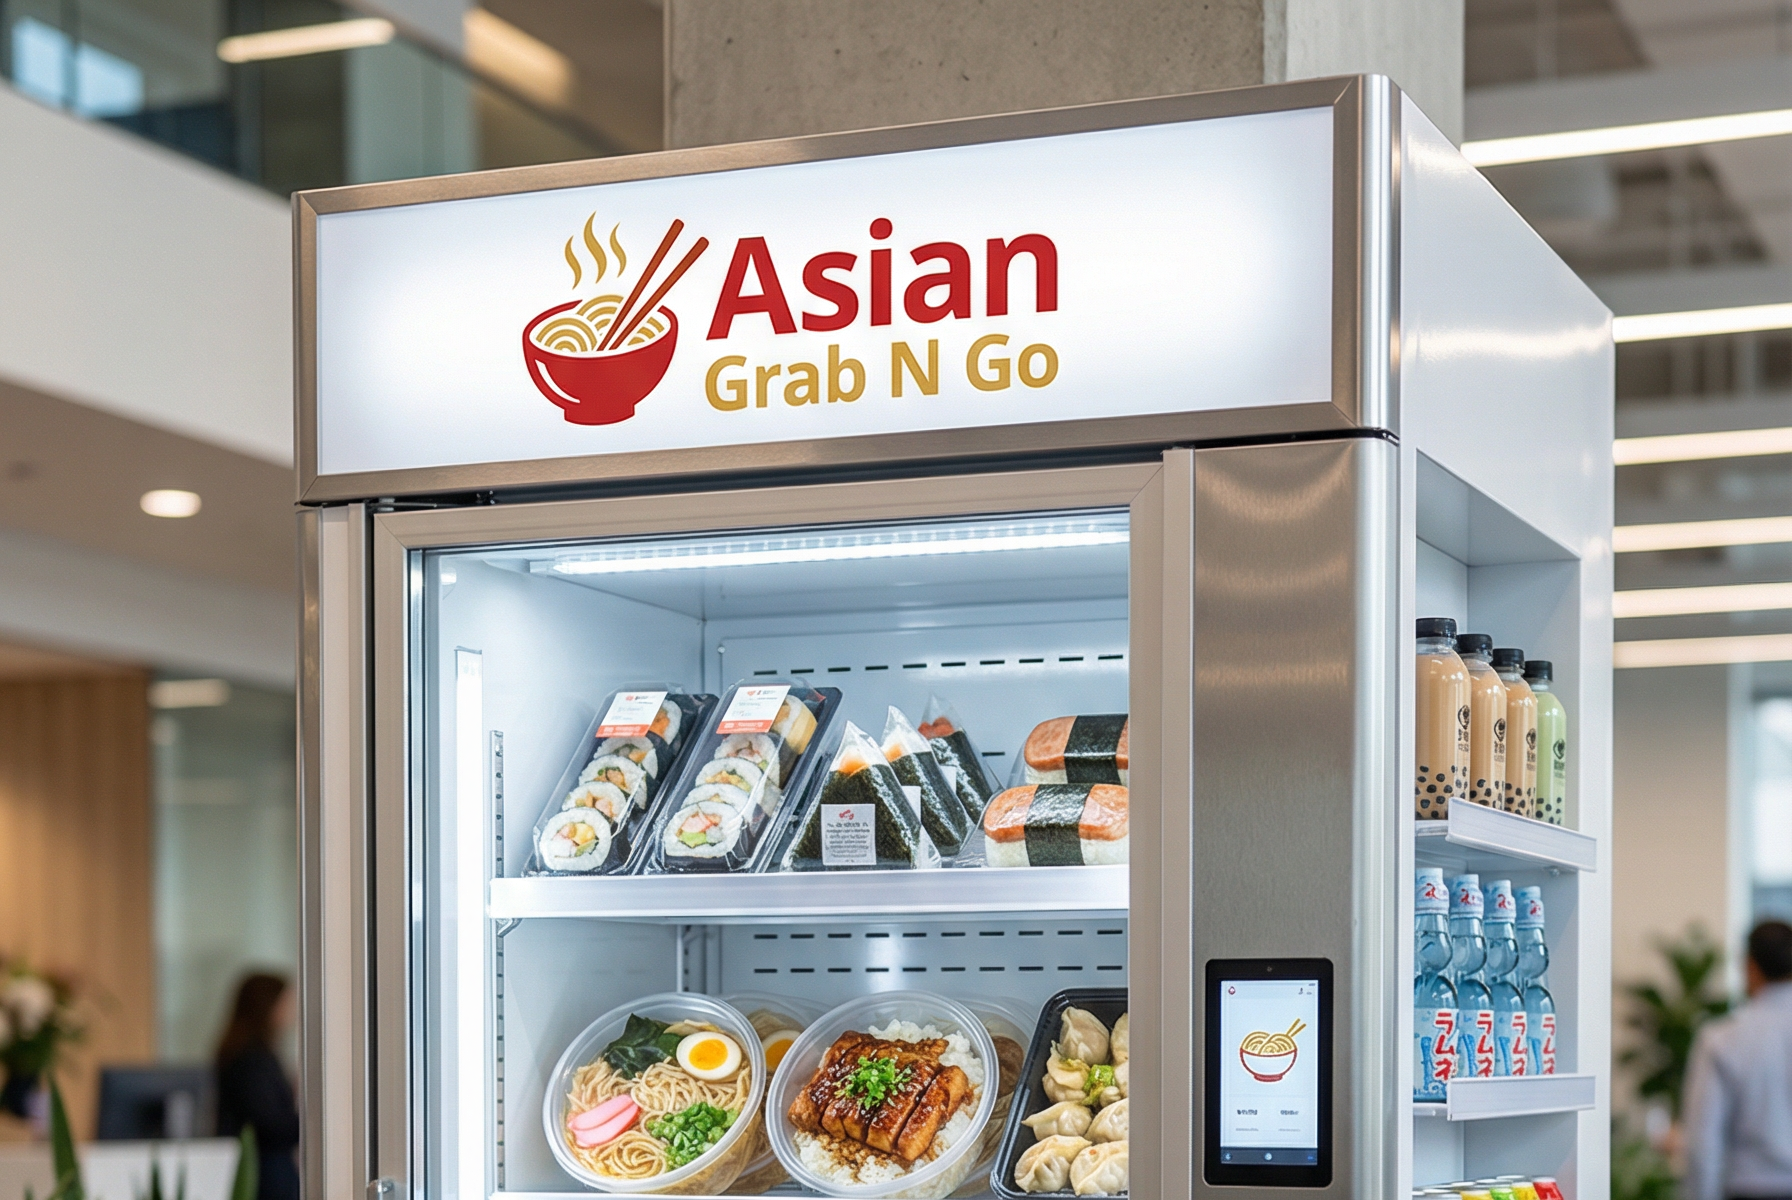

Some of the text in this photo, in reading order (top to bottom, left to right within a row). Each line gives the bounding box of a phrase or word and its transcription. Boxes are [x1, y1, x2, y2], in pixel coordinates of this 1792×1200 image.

[706, 217, 1058, 340] Asian
[704, 333, 1059, 412] Grab N Go
